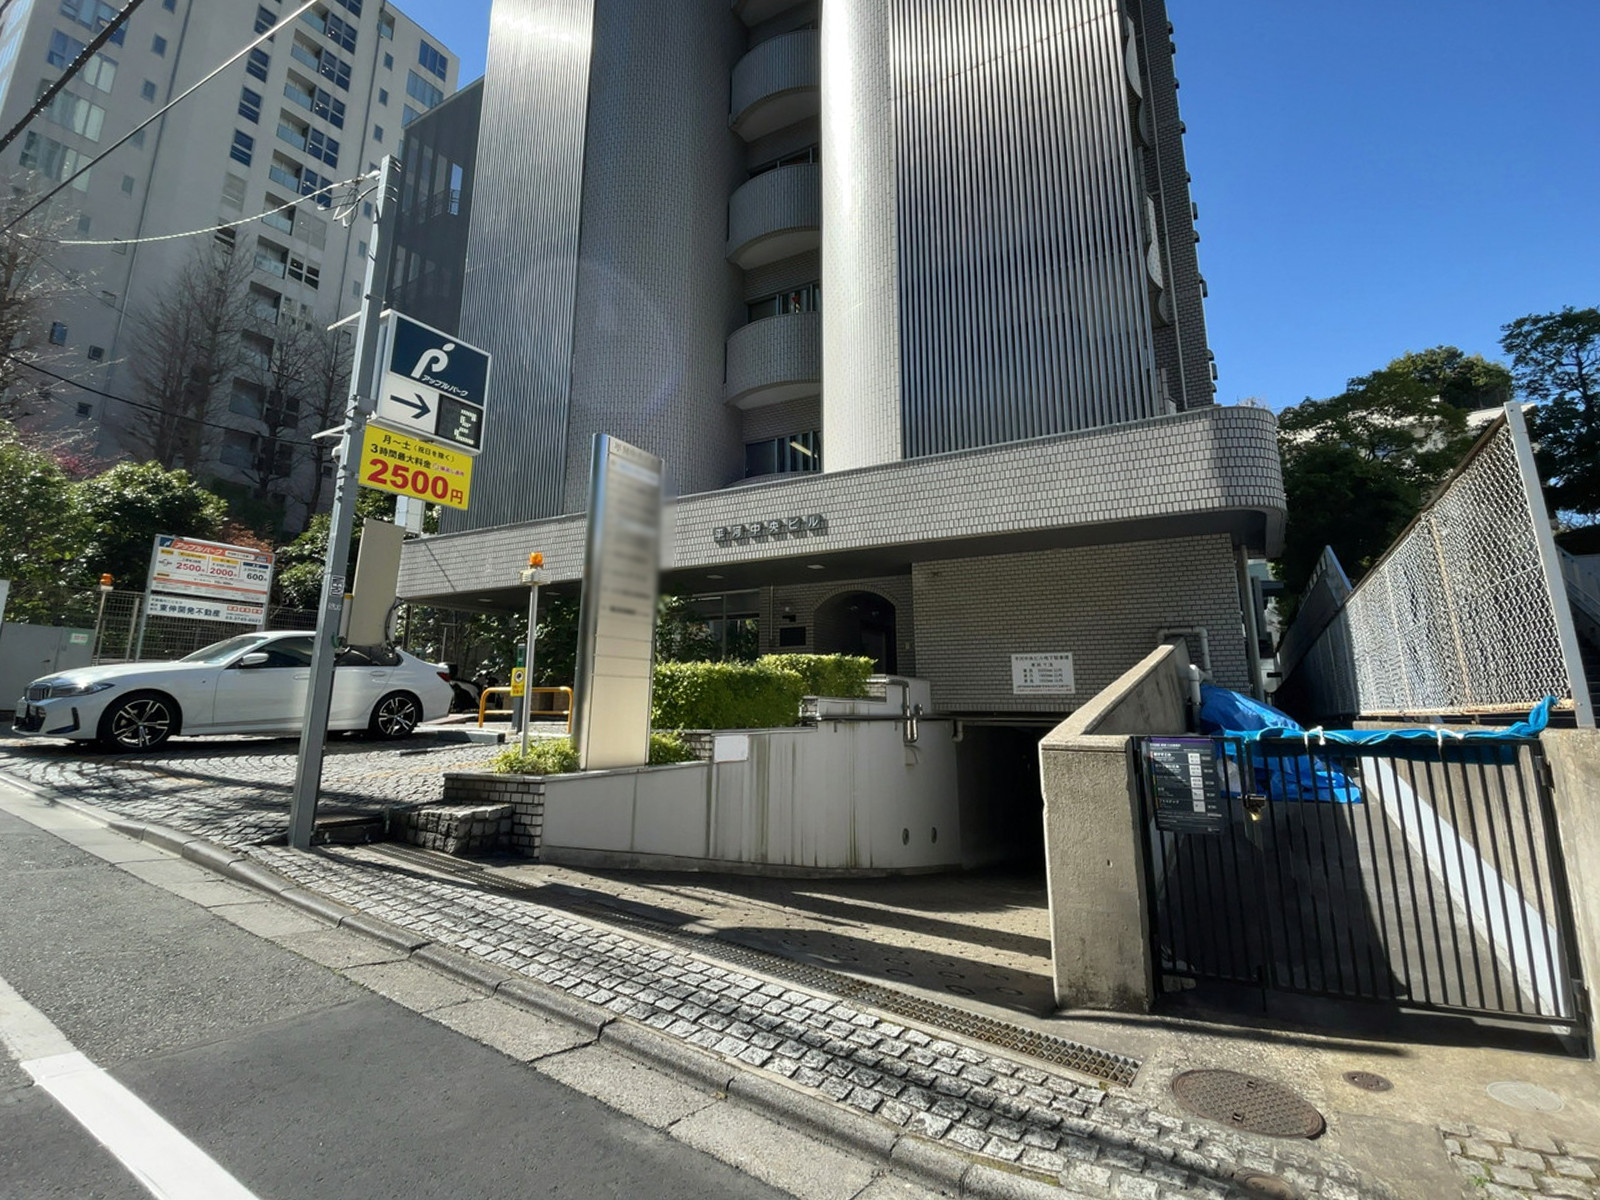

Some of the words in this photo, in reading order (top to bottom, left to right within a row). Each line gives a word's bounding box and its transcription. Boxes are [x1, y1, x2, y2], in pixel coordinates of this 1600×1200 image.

[421, 374, 469, 397] アップルパーク
[370, 443, 432, 469] 3時間最大料金
[714, 516, 820, 540] 平河中央ビル
[175, 542, 225, 556] アップルパーク
